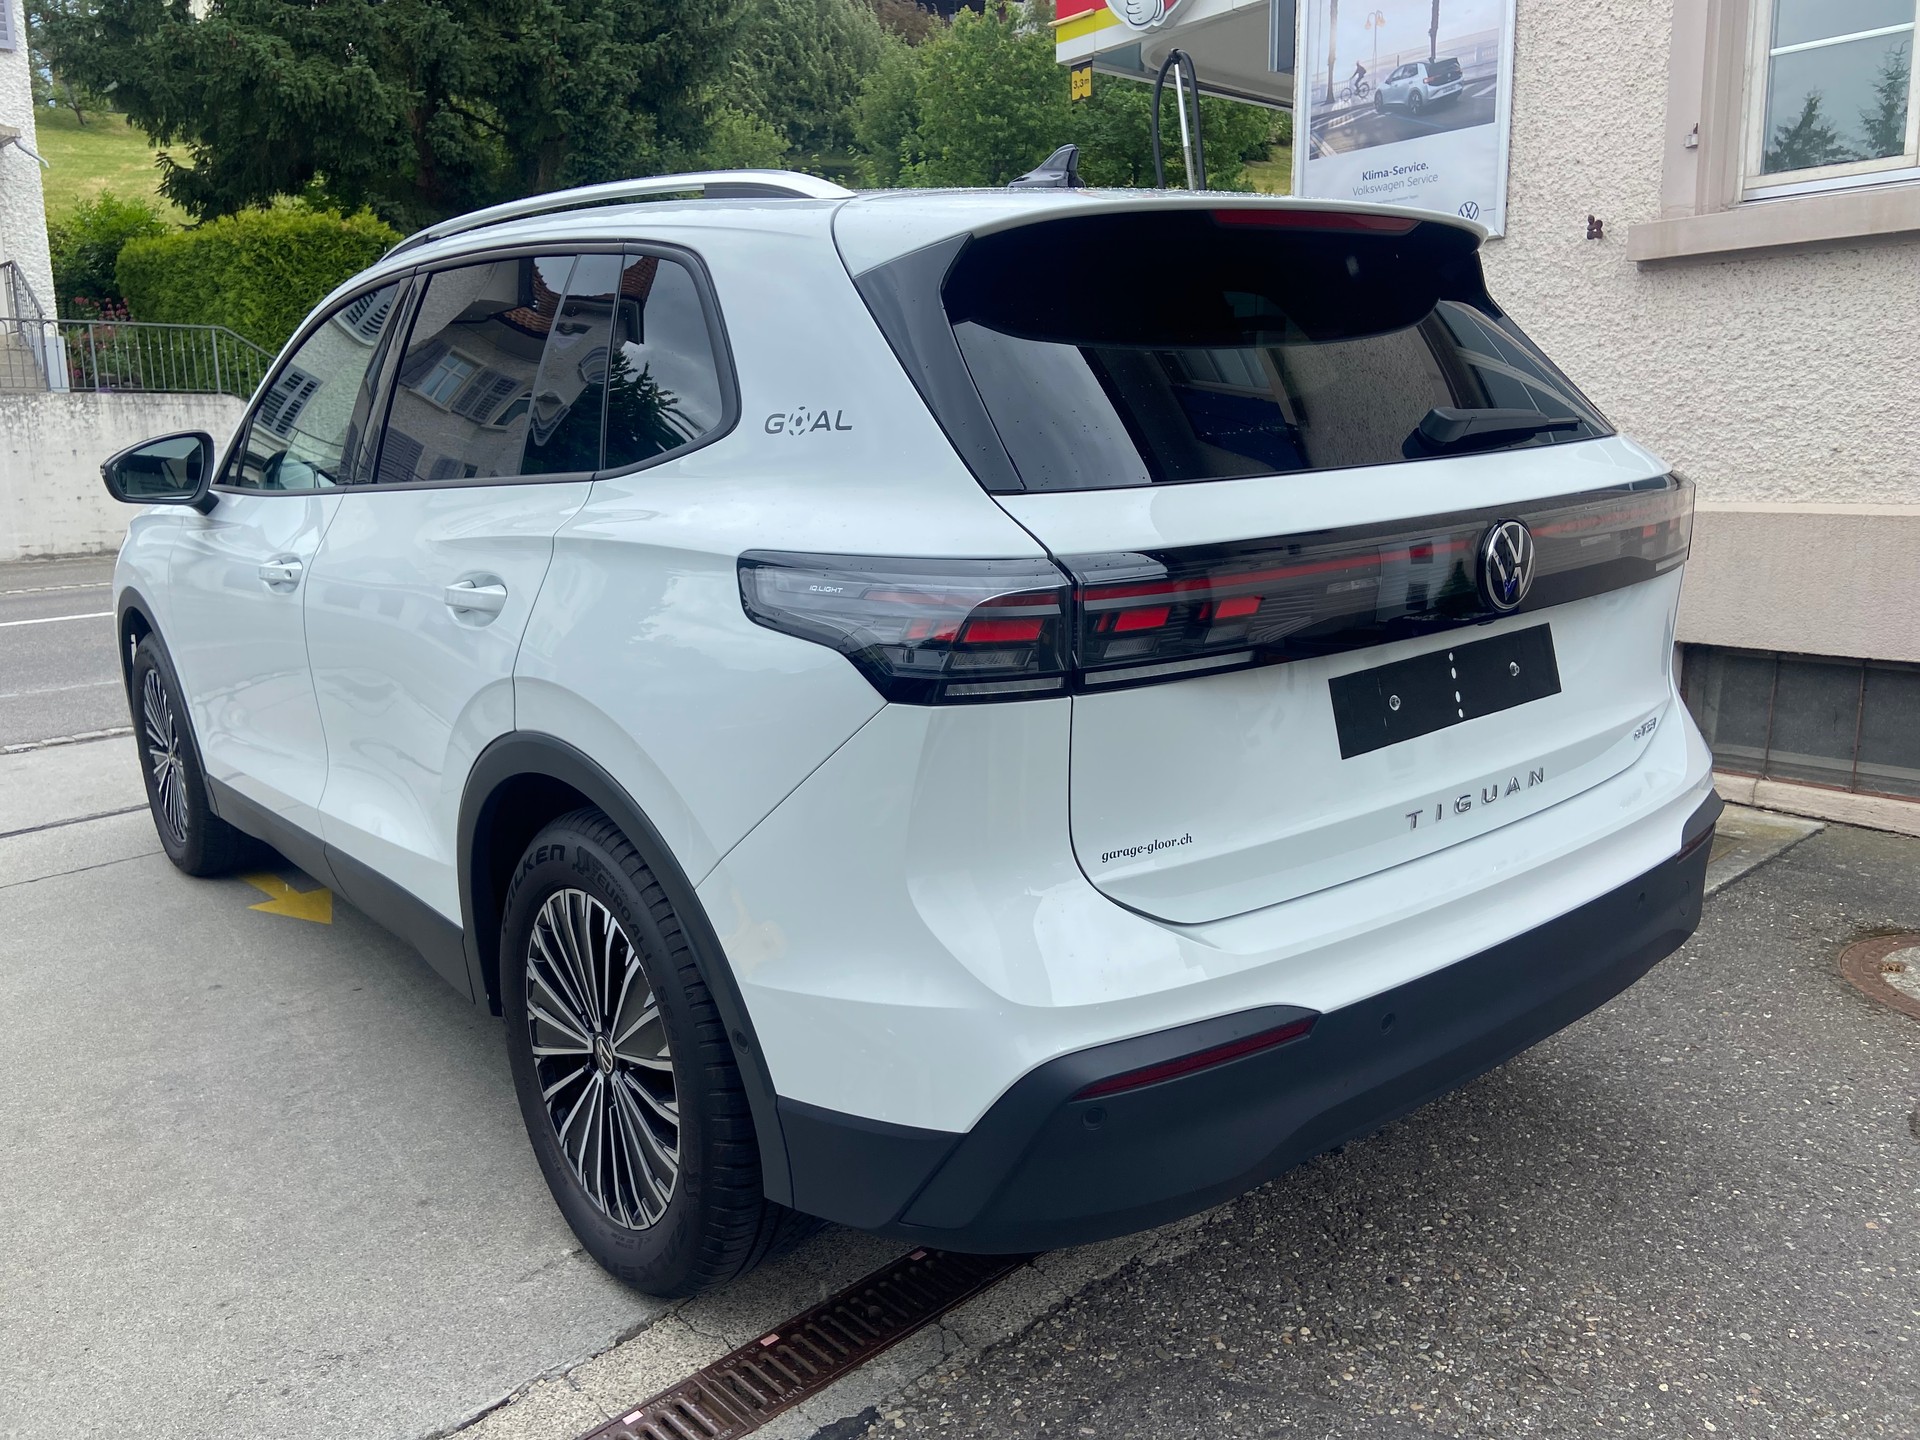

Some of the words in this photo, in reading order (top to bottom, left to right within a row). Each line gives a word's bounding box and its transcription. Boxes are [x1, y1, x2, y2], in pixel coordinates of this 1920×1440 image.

[1352, 180, 1405, 197] Volkswagen
[1407, 173, 1438, 187] Service
[1362, 161, 1429, 182] Klima-Service.
[1405, 767, 1546, 830] TIGUAN
[1101, 832, 1193, 864] garage-gloor.ch
